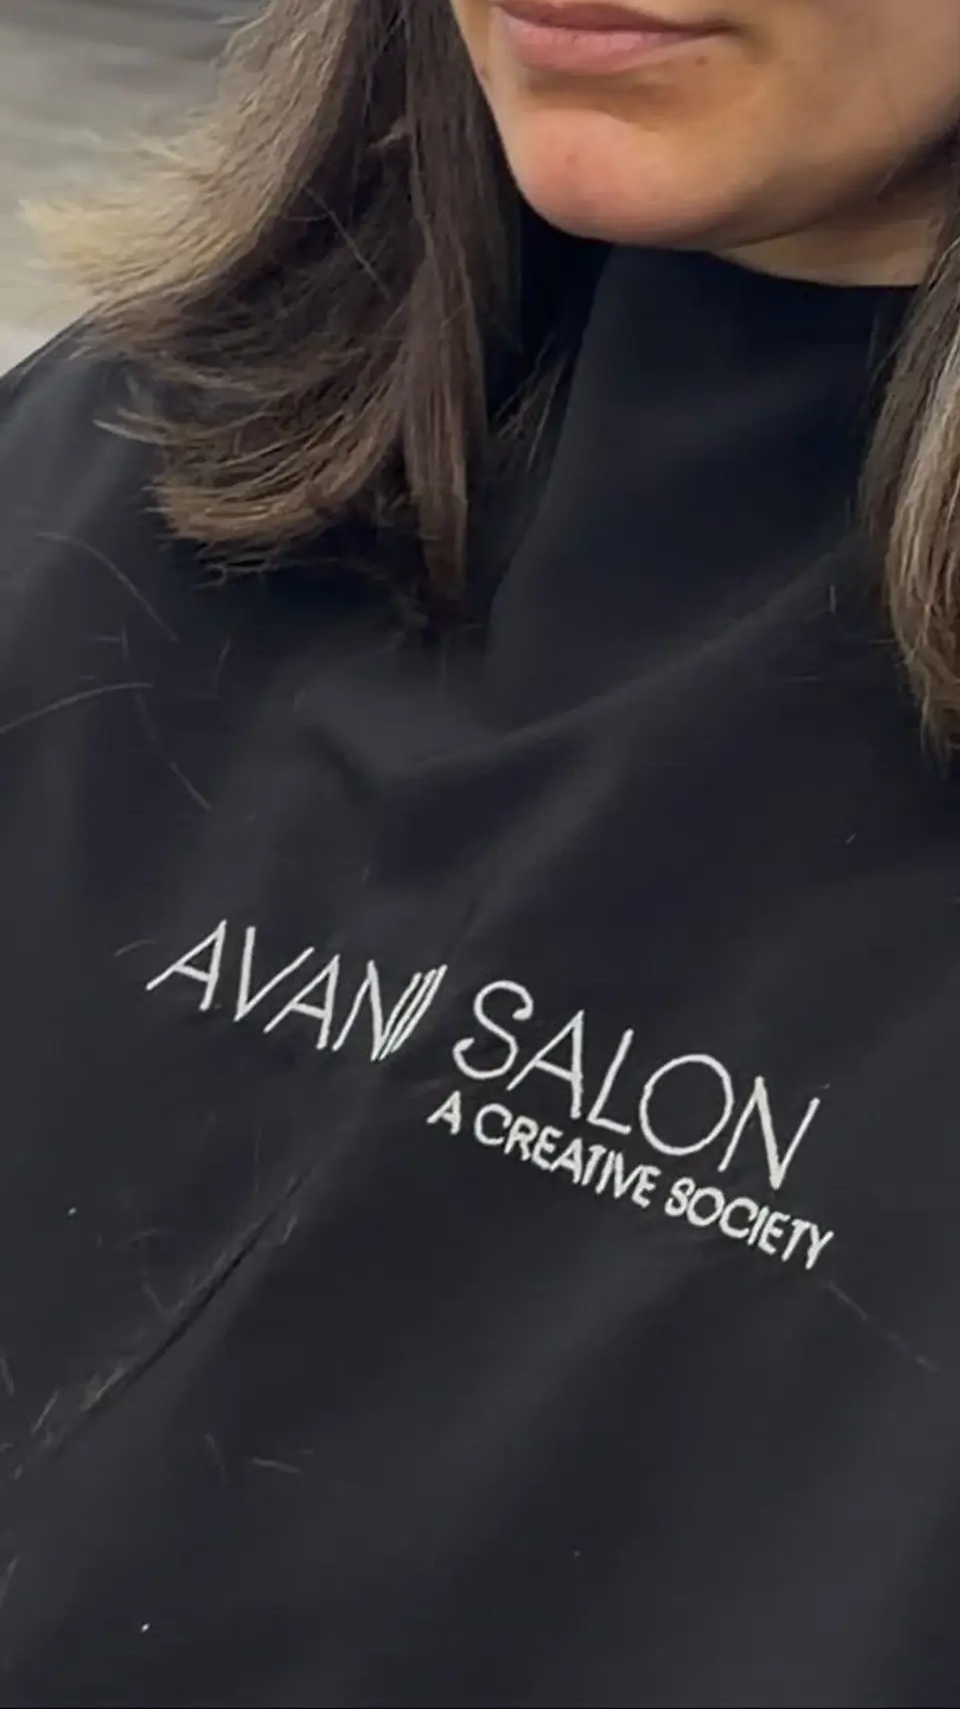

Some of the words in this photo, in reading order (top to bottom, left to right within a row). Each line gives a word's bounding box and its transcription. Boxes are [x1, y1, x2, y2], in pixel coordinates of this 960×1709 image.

[426, 1090, 462, 1135] A
[473, 1103, 662, 1209] CREATIVE
[664, 1176, 835, 1270] SOCIETY
[452, 979, 821, 1190] SALON
